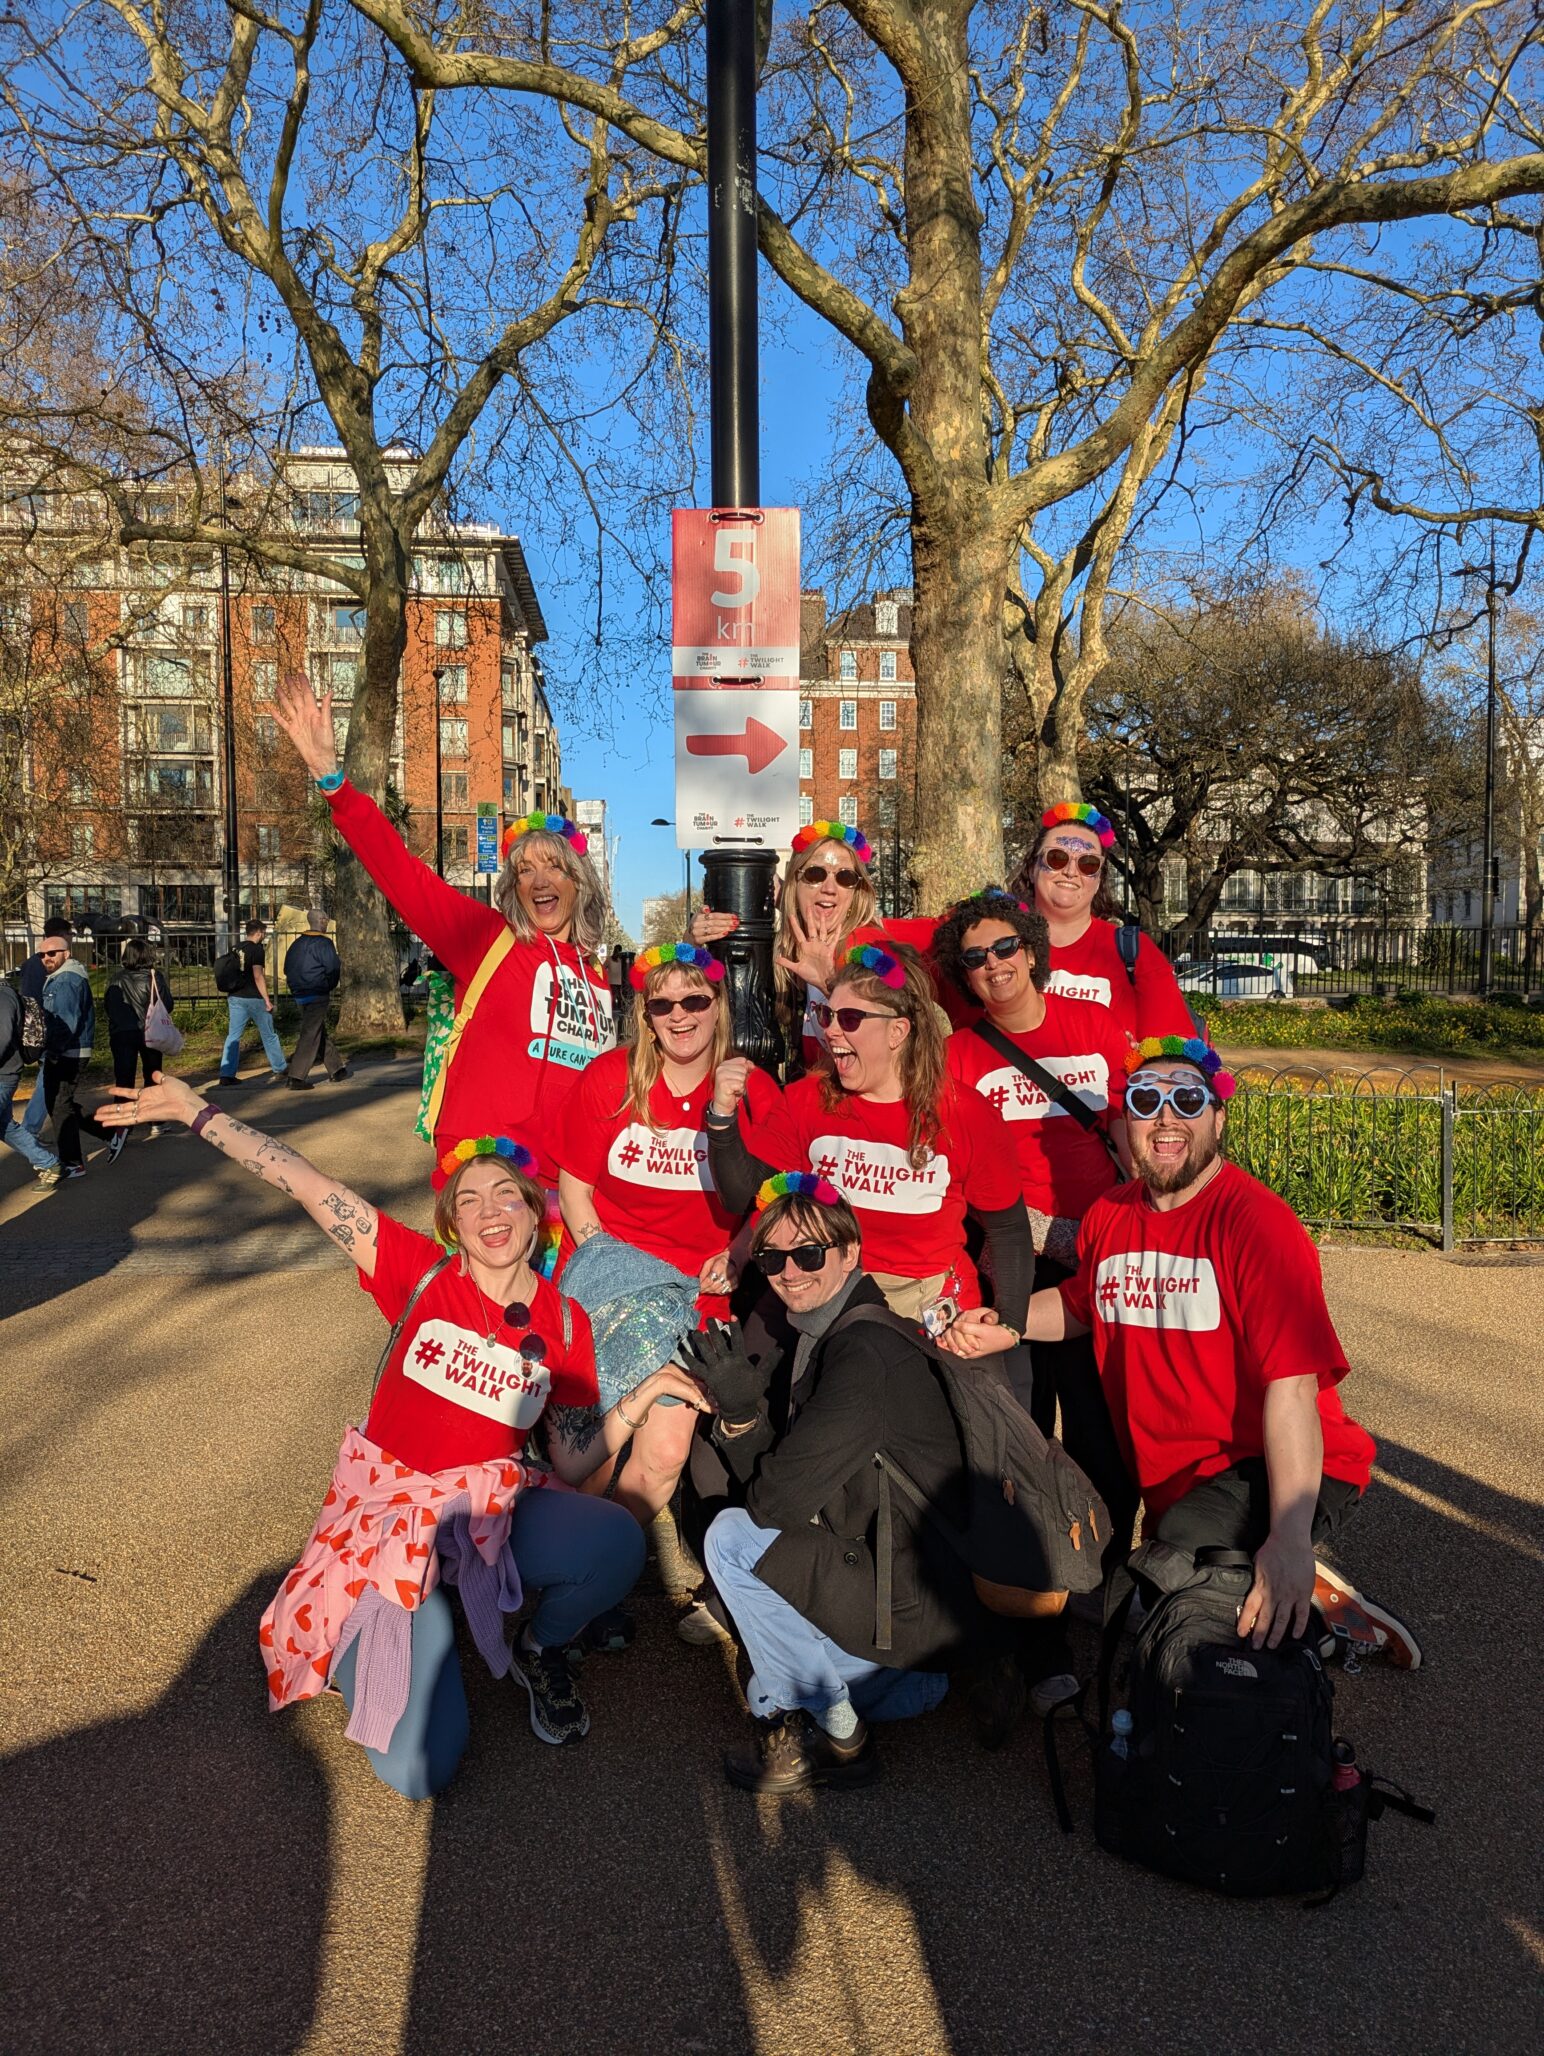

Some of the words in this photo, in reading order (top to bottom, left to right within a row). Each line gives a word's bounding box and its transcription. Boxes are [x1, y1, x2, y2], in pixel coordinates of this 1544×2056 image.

[711, 528, 761, 609] 5
[717, 616, 755, 640] km
[532, 1042, 540, 1053] A
[549, 1045, 568, 1060] URE
[1016, 1092, 1048, 1106] WA
[651, 1136, 668, 1148] THE
[648, 1146, 708, 1162] TWILIG
[847, 1148, 866, 1162] THE
[646, 1159, 696, 1176] WALK
[844, 1158, 936, 1184] TWILIGHT
[842, 1173, 896, 1196] WALK
[457, 1338, 479, 1356] THE
[450, 1348, 542, 1398] TWILIGHT
[444, 1364, 506, 1402] WALK
[1216, 1660, 1244, 1672] NORTH
[1224, 1668, 1244, 1676] FACE
